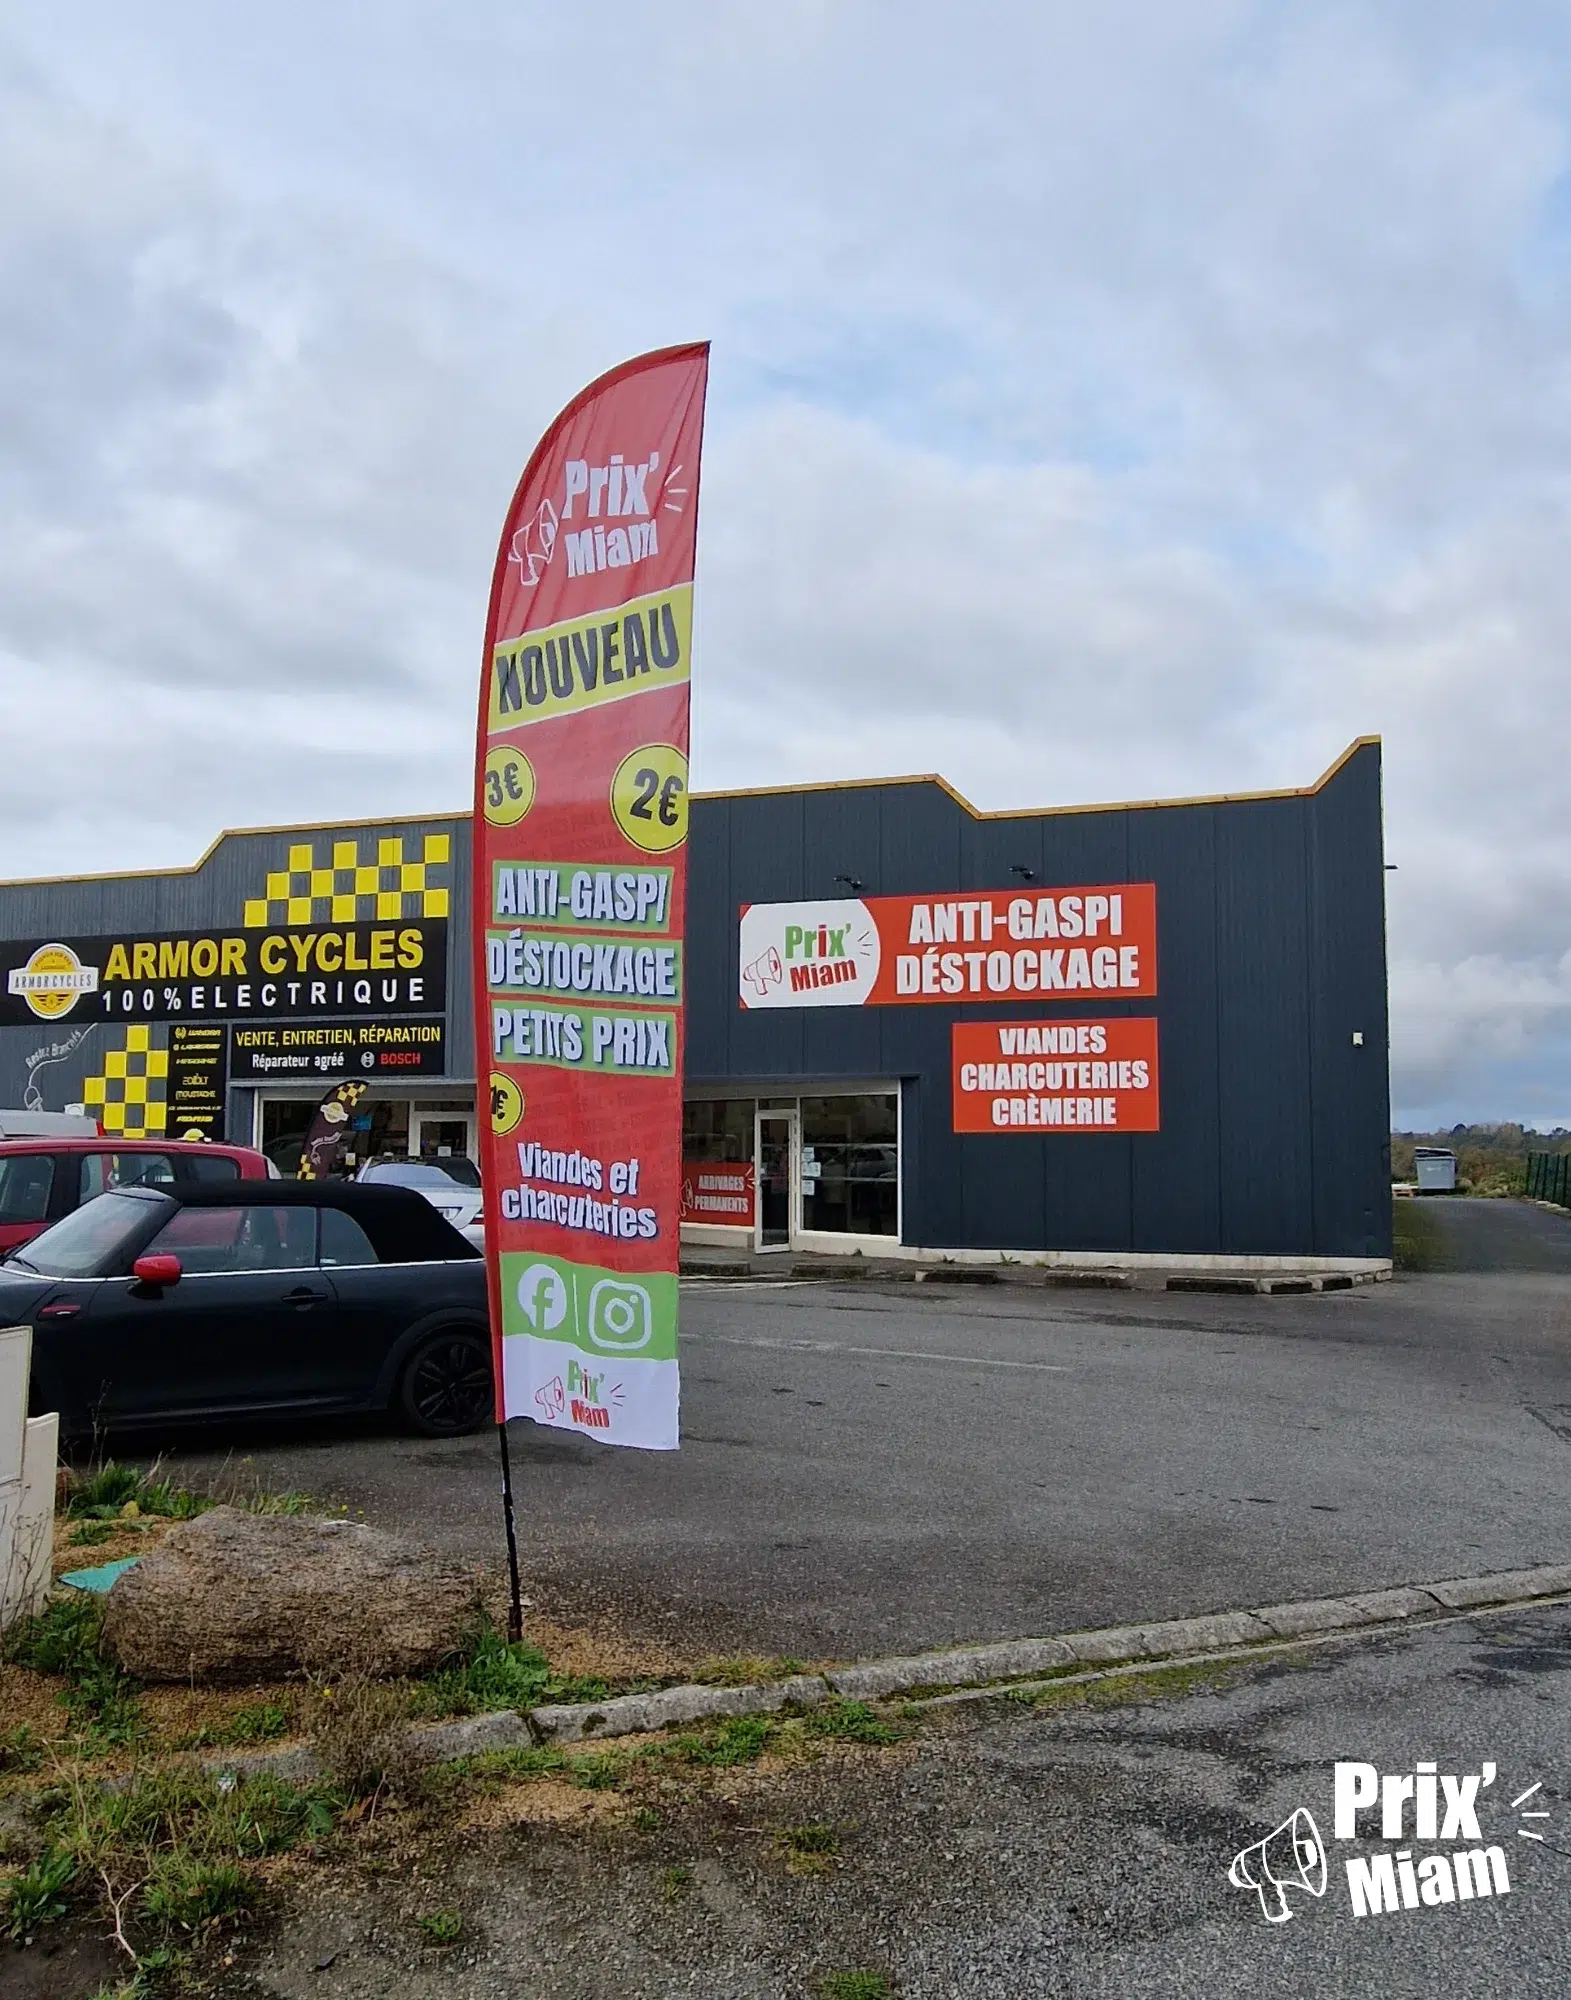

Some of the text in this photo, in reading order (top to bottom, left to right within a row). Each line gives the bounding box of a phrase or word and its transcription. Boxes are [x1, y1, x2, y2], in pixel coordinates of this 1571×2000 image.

[561, 451, 660, 519] Prix'
[564, 518, 659, 579] Miam
[495, 602, 680, 714] NOUVEAU
[484, 762, 524, 808] 3€
[629, 768, 684, 827] 2€
[496, 867, 669, 923] ANTI-GASPI
[908, 895, 1123, 945] ANTI-GASPI
[103, 928, 424, 981] ARMOR CYCLES
[486, 927, 677, 997] DÉSTOCKAGE
[784, 923, 852, 960] Prix'
[789, 957, 858, 993] Miam
[895, 945, 1140, 996] DÉSTOCKAGE
[236, 1031, 280, 1047] VENTE,
[282, 1028, 356, 1046] ENTRETIEN,
[359, 1024, 441, 1044] RÉPARATION
[252, 1051, 421, 1071] Réparateur agréé BOSCH
[494, 1007, 670, 1068] PETITS PRIX
[999, 1025, 1107, 1055] VIANDES
[960, 1060, 1150, 1092] CHARCUTERIES
[992, 1093, 1117, 1127] CRÈMERIE
[517, 1142, 640, 1196] Viandes et
[501, 1183, 658, 1239] charcuteries
